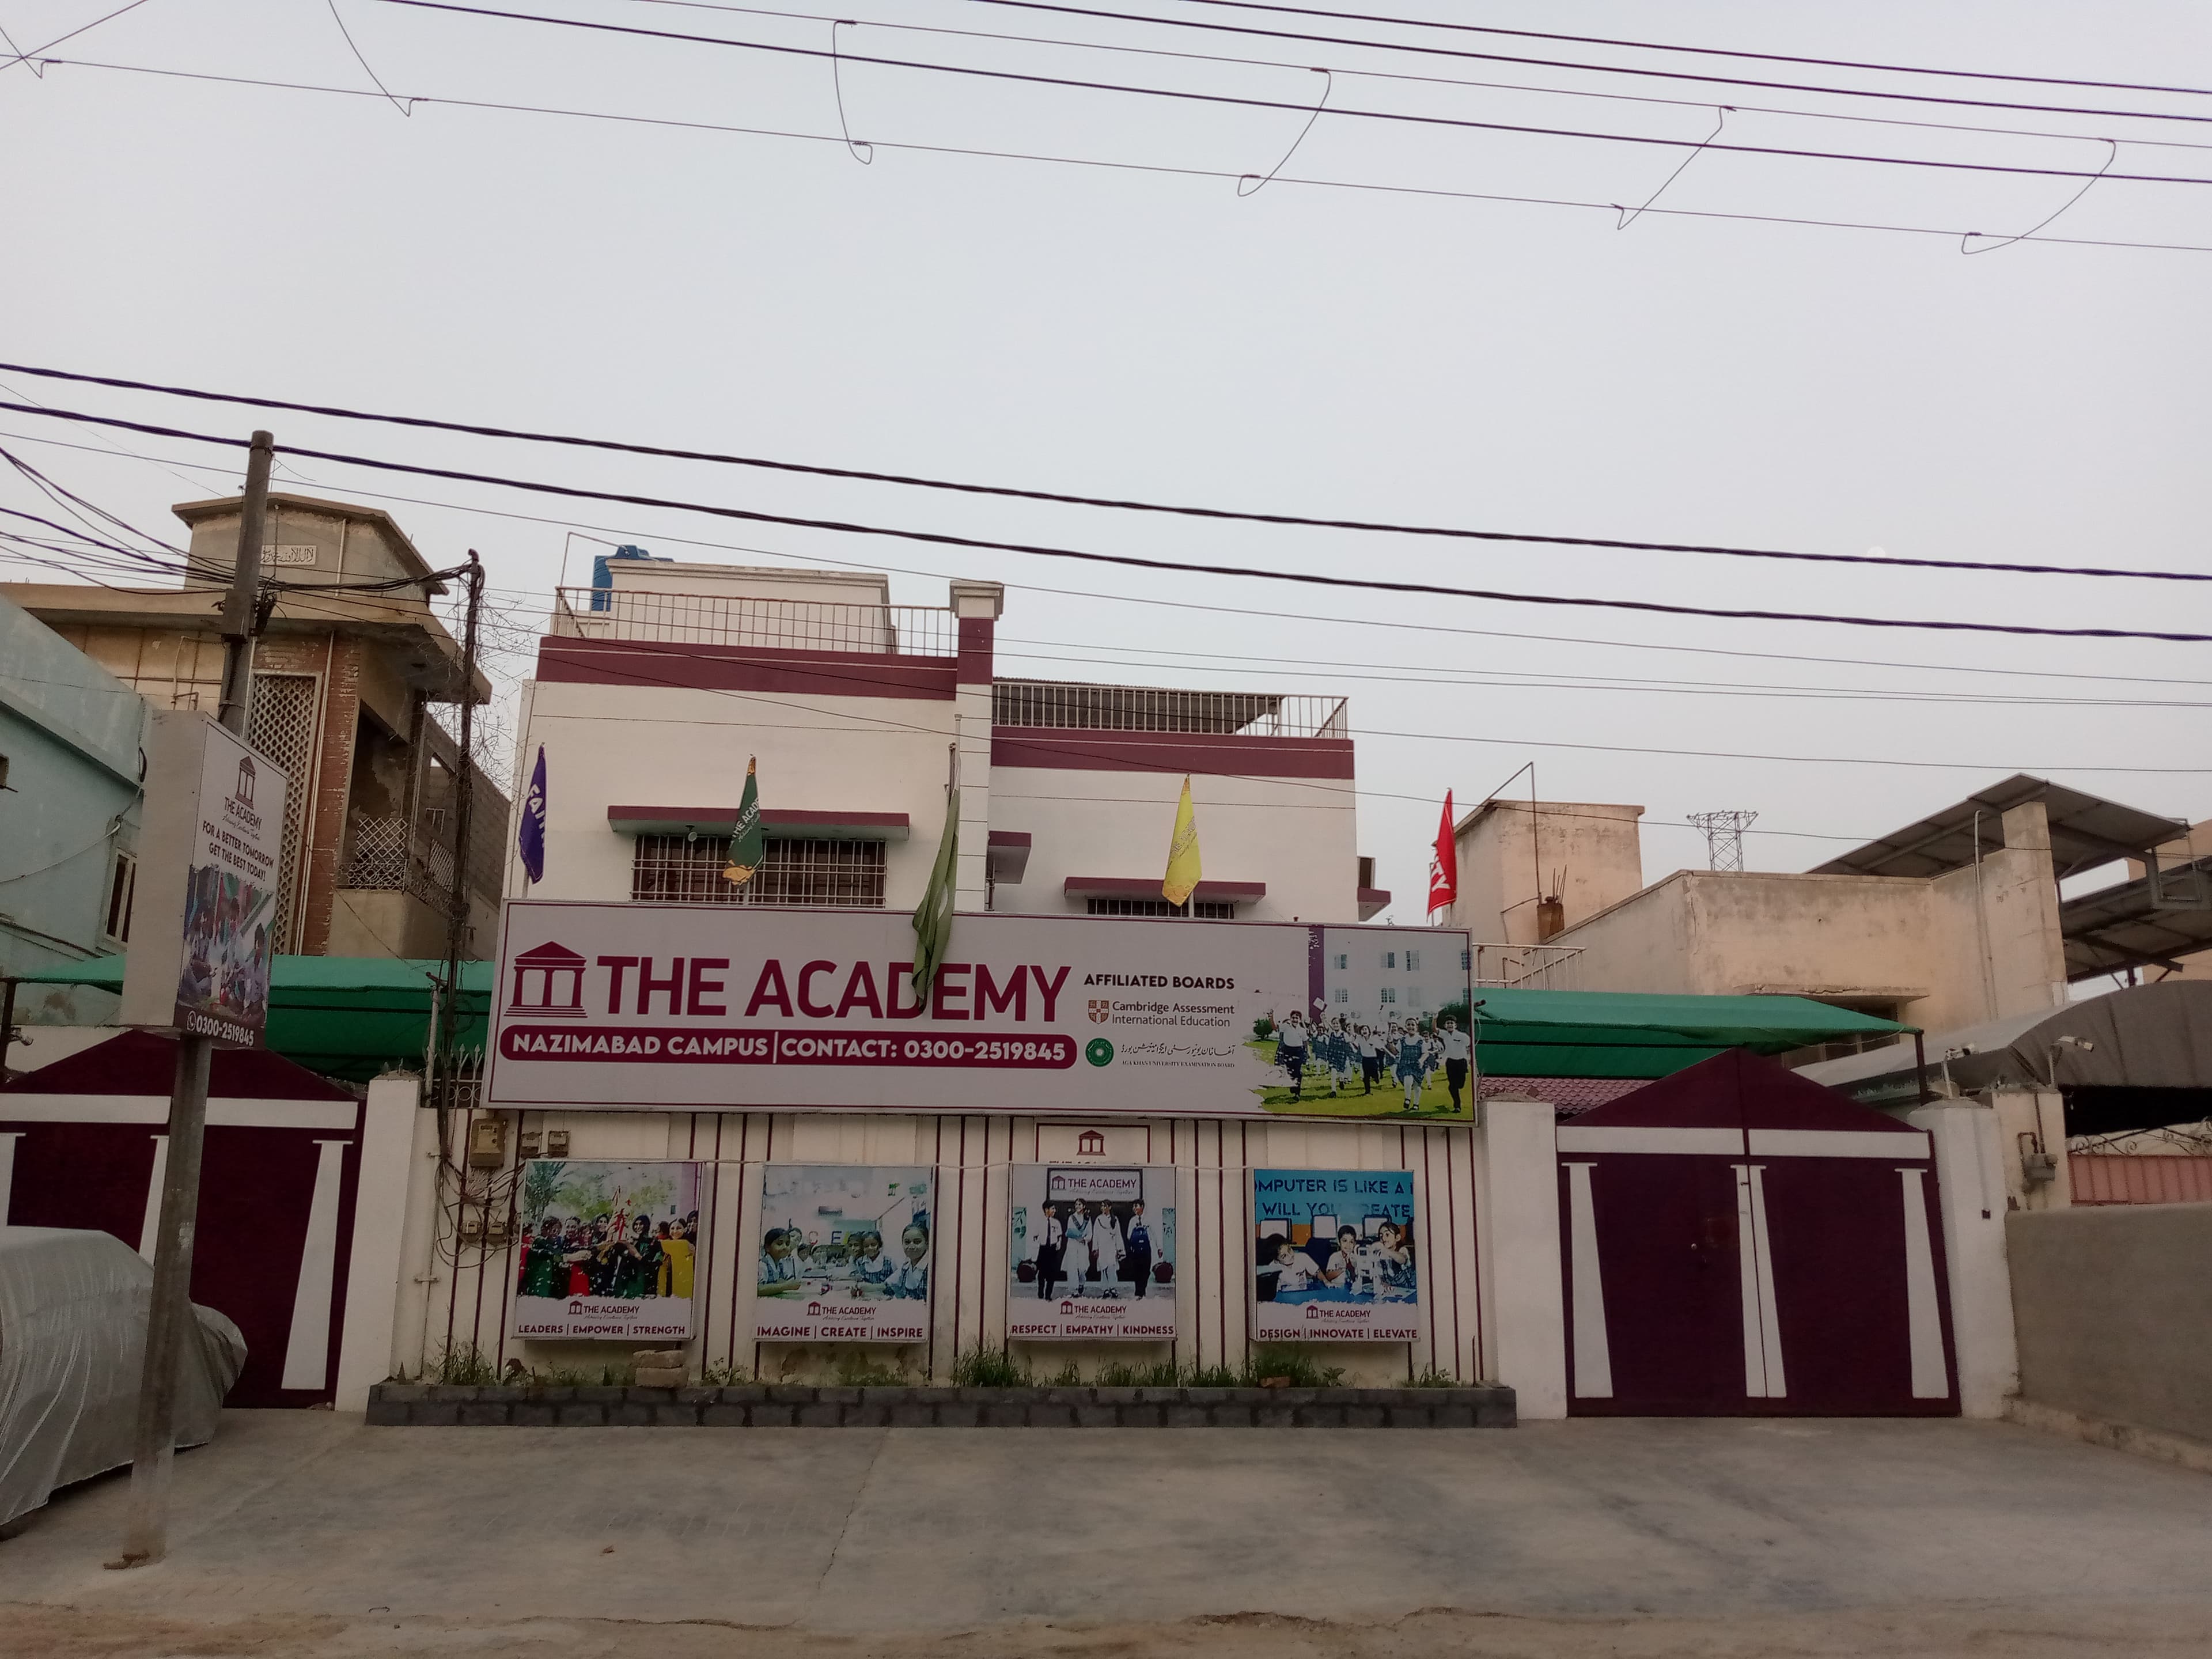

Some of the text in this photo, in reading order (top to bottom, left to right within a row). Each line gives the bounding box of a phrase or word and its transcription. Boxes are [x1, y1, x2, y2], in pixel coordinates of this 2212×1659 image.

[225, 796, 236, 815] THE
[236, 804, 262, 830] ACADEMY
[527, 783, 544, 848] FAI
[203, 820, 215, 836] FOR
[215, 828, 220, 840] A
[222, 831, 241, 851] BETTER
[243, 842, 274, 868] TOMORROW
[209, 842, 266, 881] GET THE BEST TODAY!
[1084, 974, 1234, 989] AFFILIATED BOARDS
[597, 956, 1072, 1022] THE ACADEMY
[1112, 1001, 1235, 1014] Cambridge Assessment
[1112, 1014, 1230, 1027] International Education
[196, 1014, 254, 1046] 0300-2519845
[513, 1034, 661, 1054] NAZIMABAD
[667, 1036, 768, 1056] CAMPUS
[781, 1038, 897, 1058] CONTACT:
[904, 1040, 1065, 1060] 0300-2519845
[1068, 1179, 1137, 1188] THE ACADEMY
[1255, 1179, 1327, 1192] MPUTER
[1334, 1180, 1347, 1192] IS
[1355, 1181, 1388, 1194] LIKE
[1395, 1182, 1404, 1194] A
[1262, 1202, 1300, 1215] WILL
[584, 1305, 639, 1314] THE ACADEMY
[822, 1306, 876, 1315] THE ACADEMY
[518, 1324, 685, 1335] LEADERS EMPOWER STRENGTH
[757, 1326, 923, 1338] IMAGINE CREATE INSPIRE
[1012, 1325, 1174, 1335] RESPECT EMPATHY KINDNESS
[1260, 1329, 1417, 1338] DESIGN INNOVATE ELEVATE
